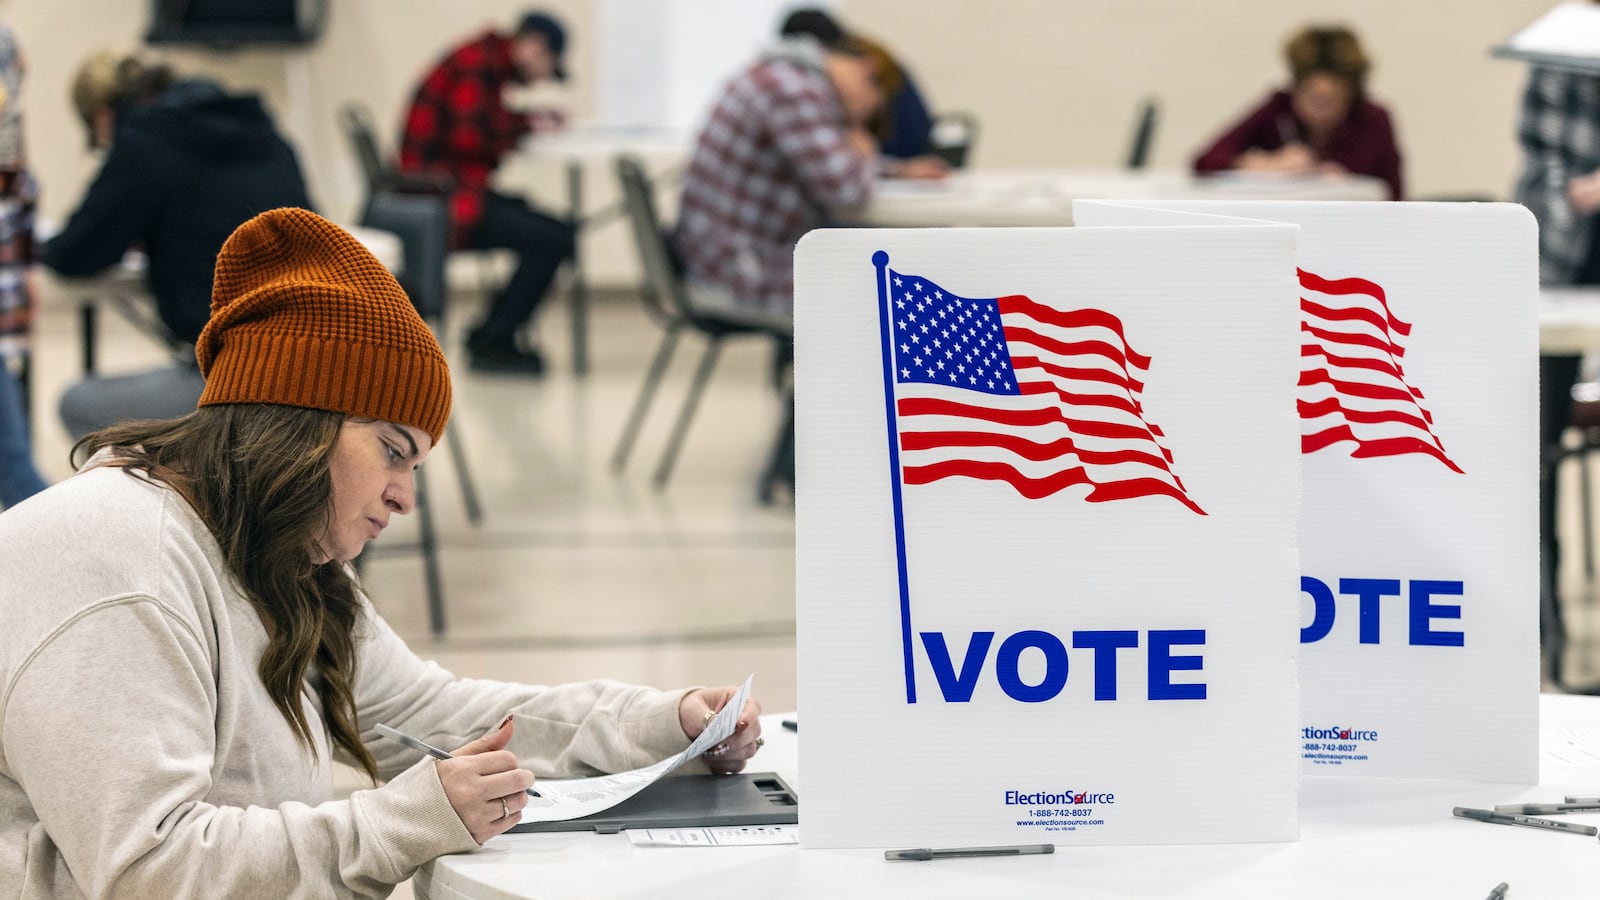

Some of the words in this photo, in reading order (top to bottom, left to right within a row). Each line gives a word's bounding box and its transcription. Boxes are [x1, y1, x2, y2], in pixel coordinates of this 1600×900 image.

[919, 629, 1208, 703] VOTE
[1005, 790, 1115, 805] ElectionSource
[1029, 809, 1092, 817] 1-888-742-8037
[1016, 819, 1104, 827] www.electionsource.com
